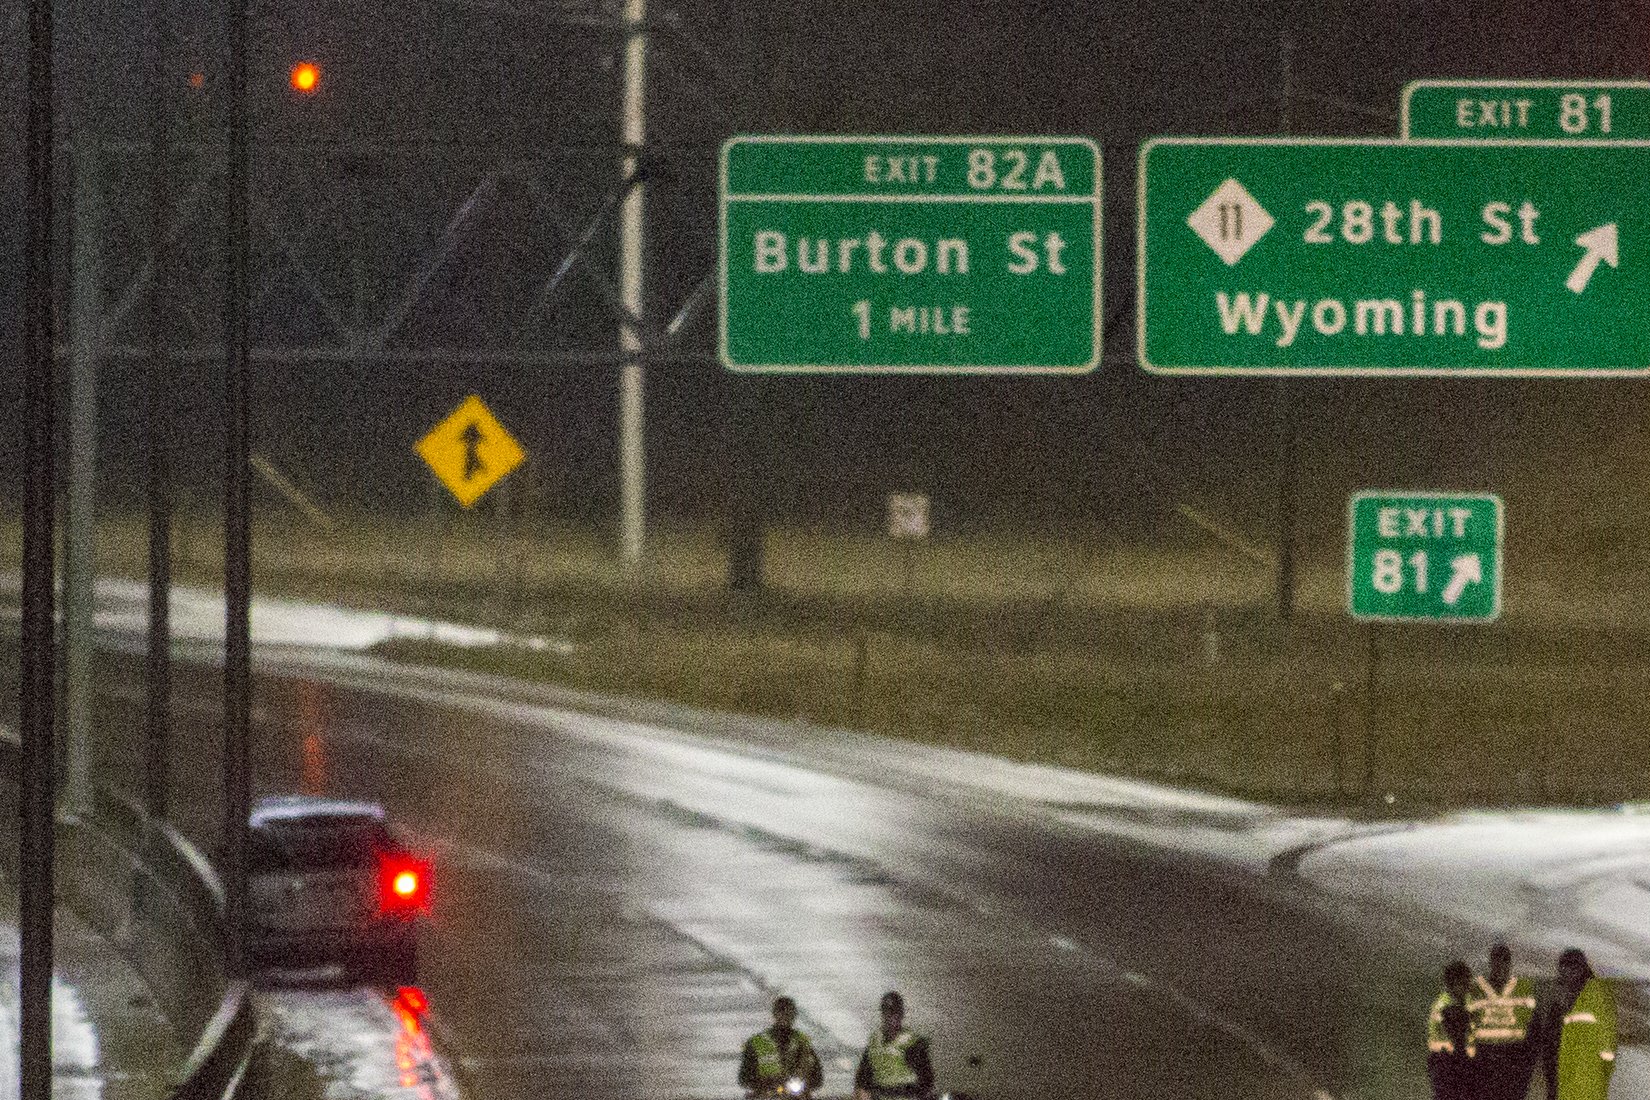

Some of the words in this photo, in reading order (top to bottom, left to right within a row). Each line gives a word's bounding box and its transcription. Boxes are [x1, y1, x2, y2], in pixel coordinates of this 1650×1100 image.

[1457, 100, 1531, 127] EXIT
[1558, 93, 1612, 134] 81
[864, 155, 938, 183] EXIT
[966, 150, 1064, 191] 82A
[1218, 202, 1243, 241] 11
[1303, 200, 1442, 245] 28th
[1481, 202, 1540, 246] St
[754, 230, 969, 275] Burton
[1008, 232, 1066, 275] St
[851, 301, 870, 339] 1
[890, 306, 971, 335] MILE
[1216, 290, 1509, 350] Wyoming
[1378, 507, 1472, 538] EXIT
[1372, 549, 1429, 594] 81
